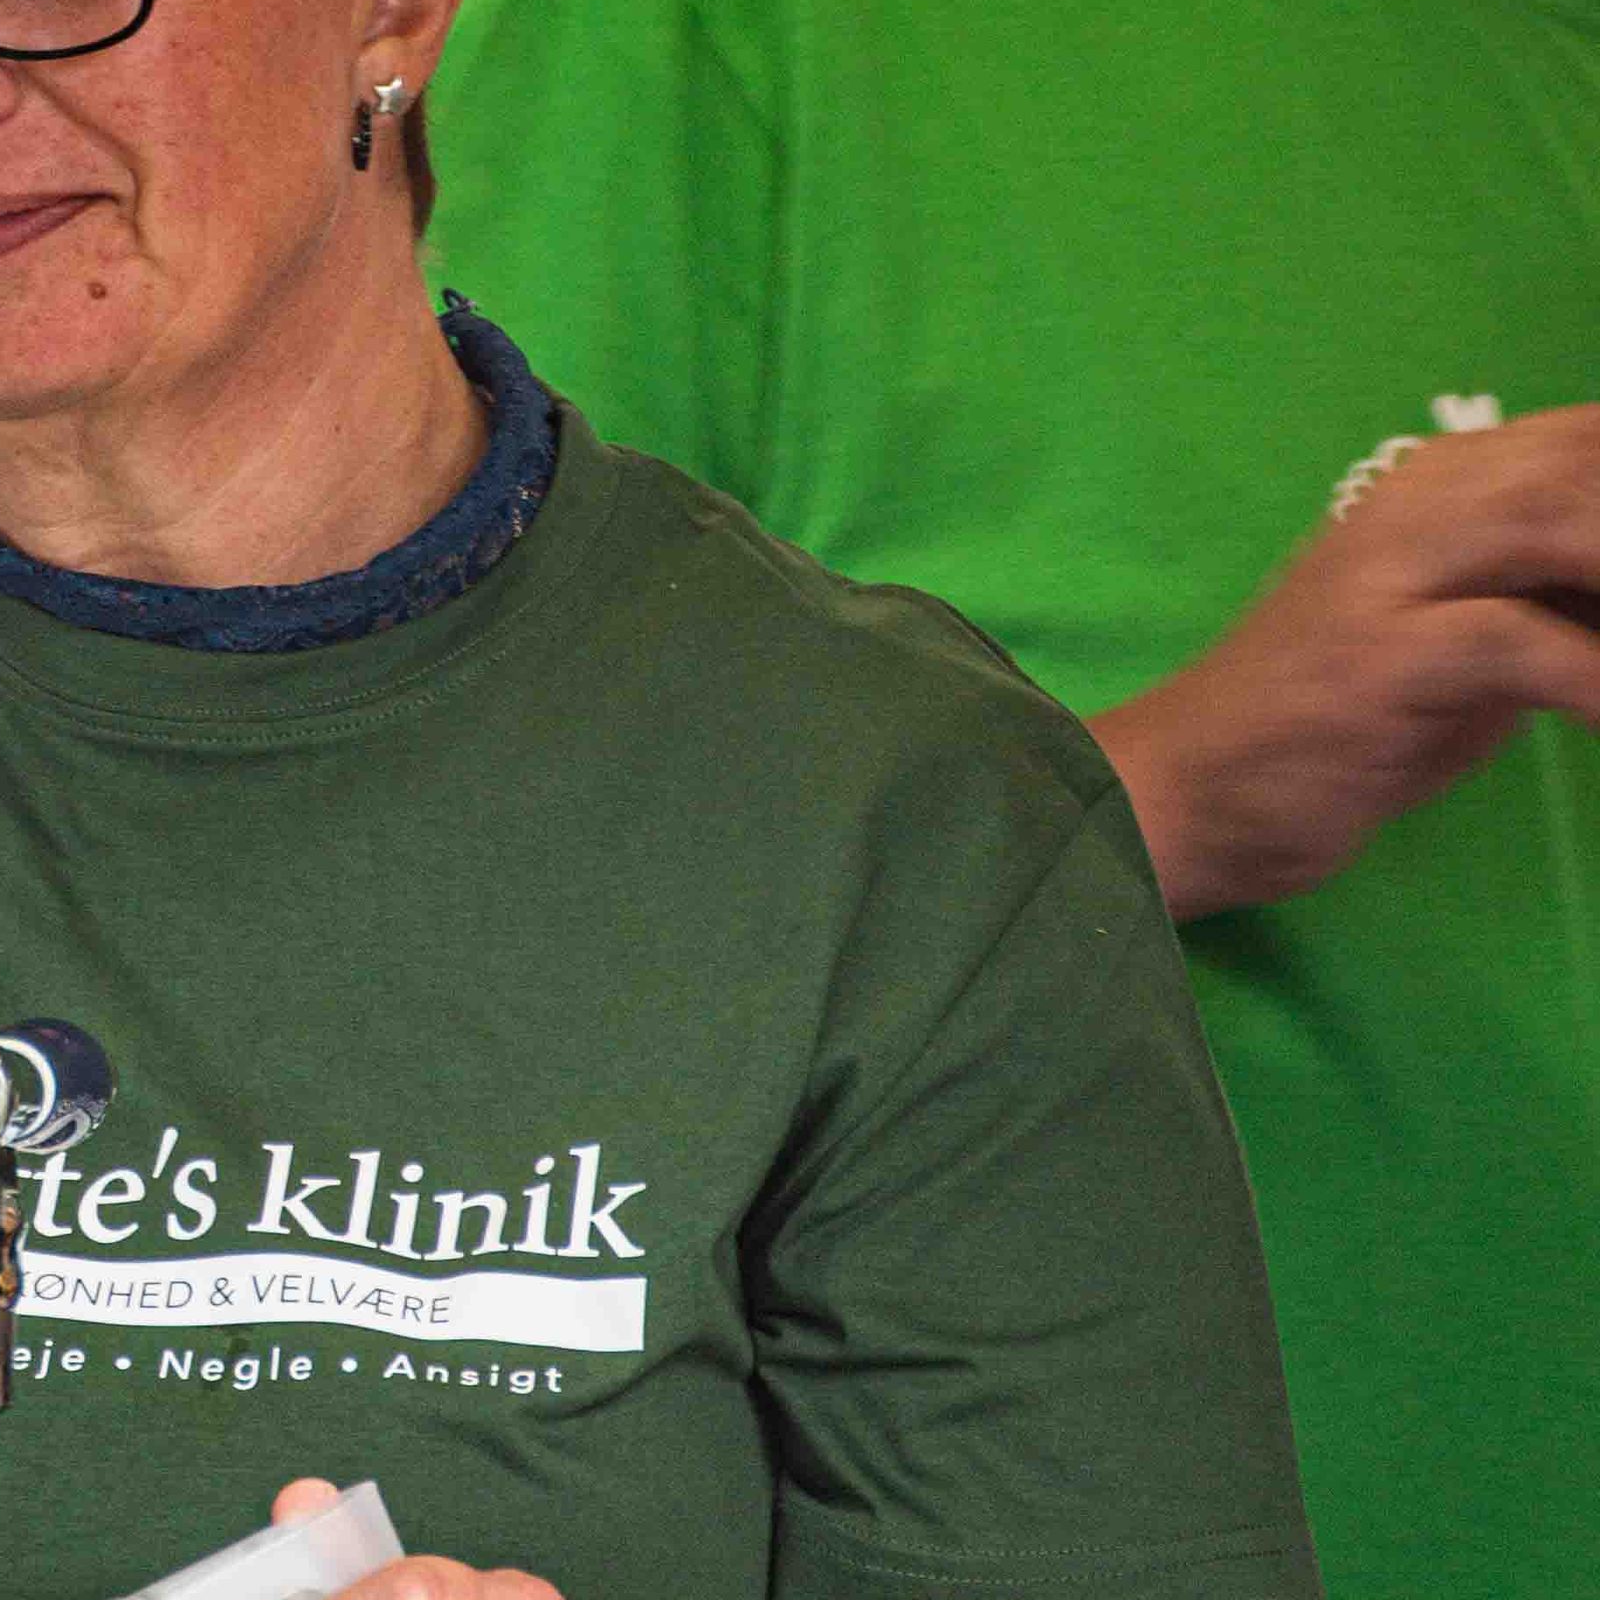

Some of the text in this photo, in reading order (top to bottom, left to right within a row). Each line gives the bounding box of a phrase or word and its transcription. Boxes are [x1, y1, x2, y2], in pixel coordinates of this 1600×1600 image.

[17, 1127, 647, 1258] te's klinik
[210, 1277, 235, 1307] &
[252, 1274, 452, 1323] VELVÆRE
[158, 1345, 314, 1391] Negle
[382, 1353, 563, 1395] Ansigt
